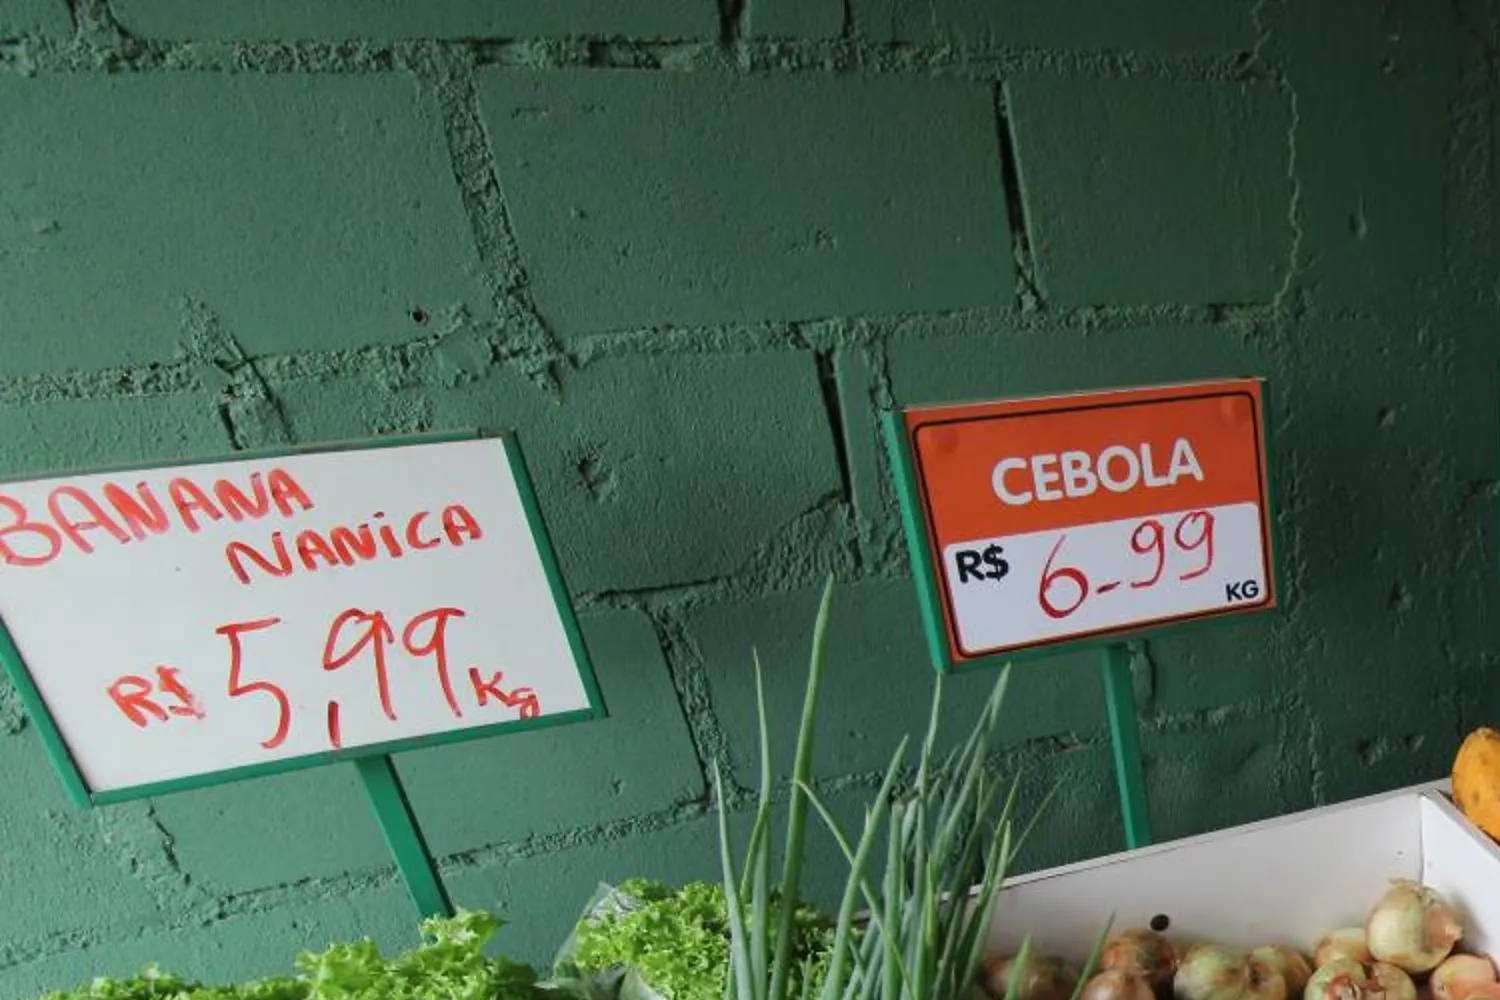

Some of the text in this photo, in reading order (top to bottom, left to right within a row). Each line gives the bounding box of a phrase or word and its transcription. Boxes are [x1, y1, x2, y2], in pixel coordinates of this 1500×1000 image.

[991, 438, 1204, 505] CEBOLA
[0, 468, 315, 566] BANANA
[956, 544, 1009, 583] R$
[1225, 580, 1260, 602] KG
[105, 664, 206, 728] R$
[215, 607, 466, 749] 5,99
